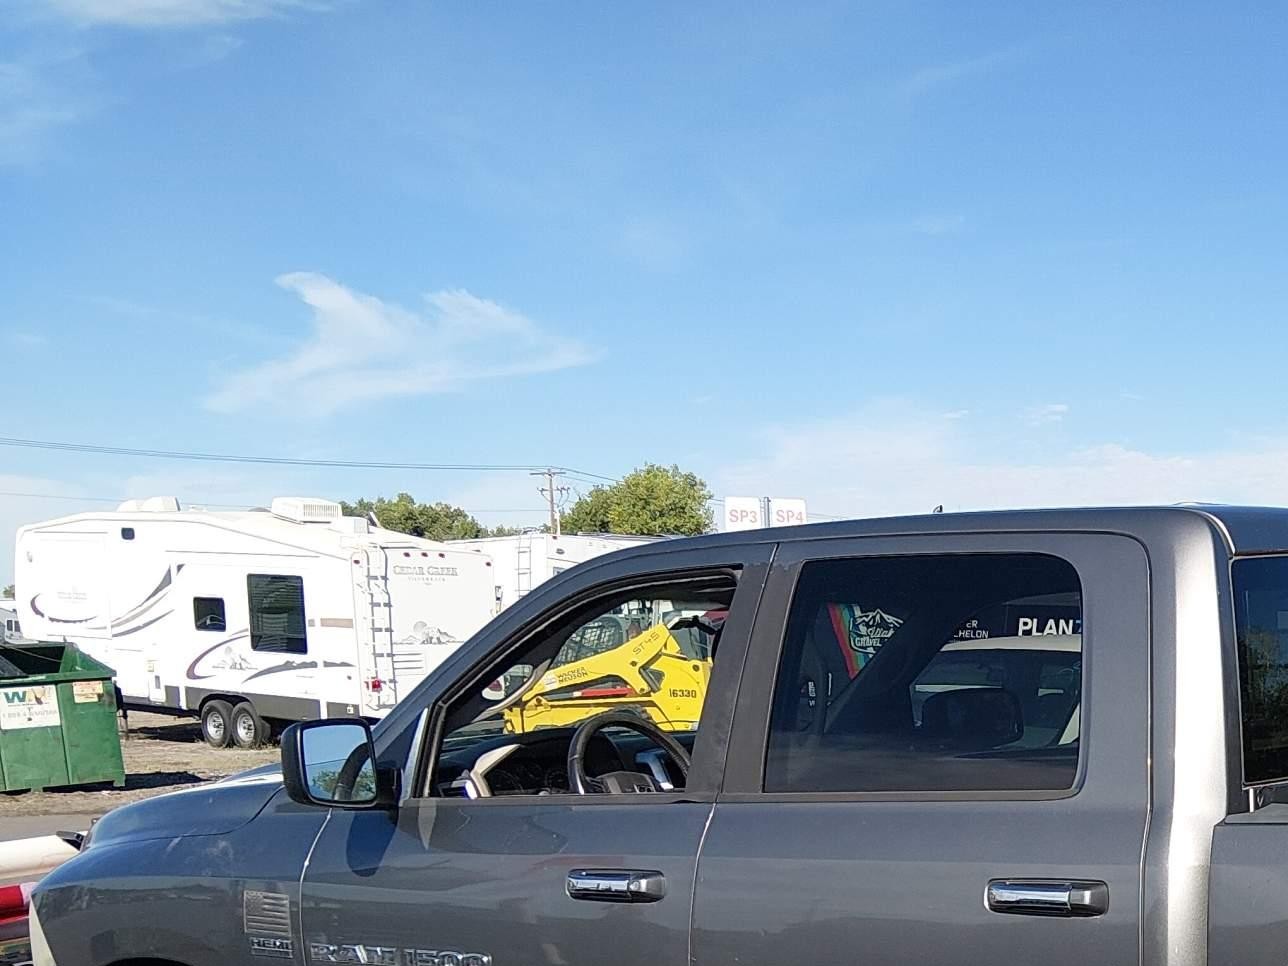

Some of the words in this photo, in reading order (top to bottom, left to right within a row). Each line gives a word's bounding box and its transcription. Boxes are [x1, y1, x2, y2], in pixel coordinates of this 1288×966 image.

[729, 509, 758, 523] SP3
[776, 509, 804, 523] SP4
[669, 688, 697, 699] 16330
[249, 935, 292, 951] HEMI
[310, 942, 401, 966] RAM
